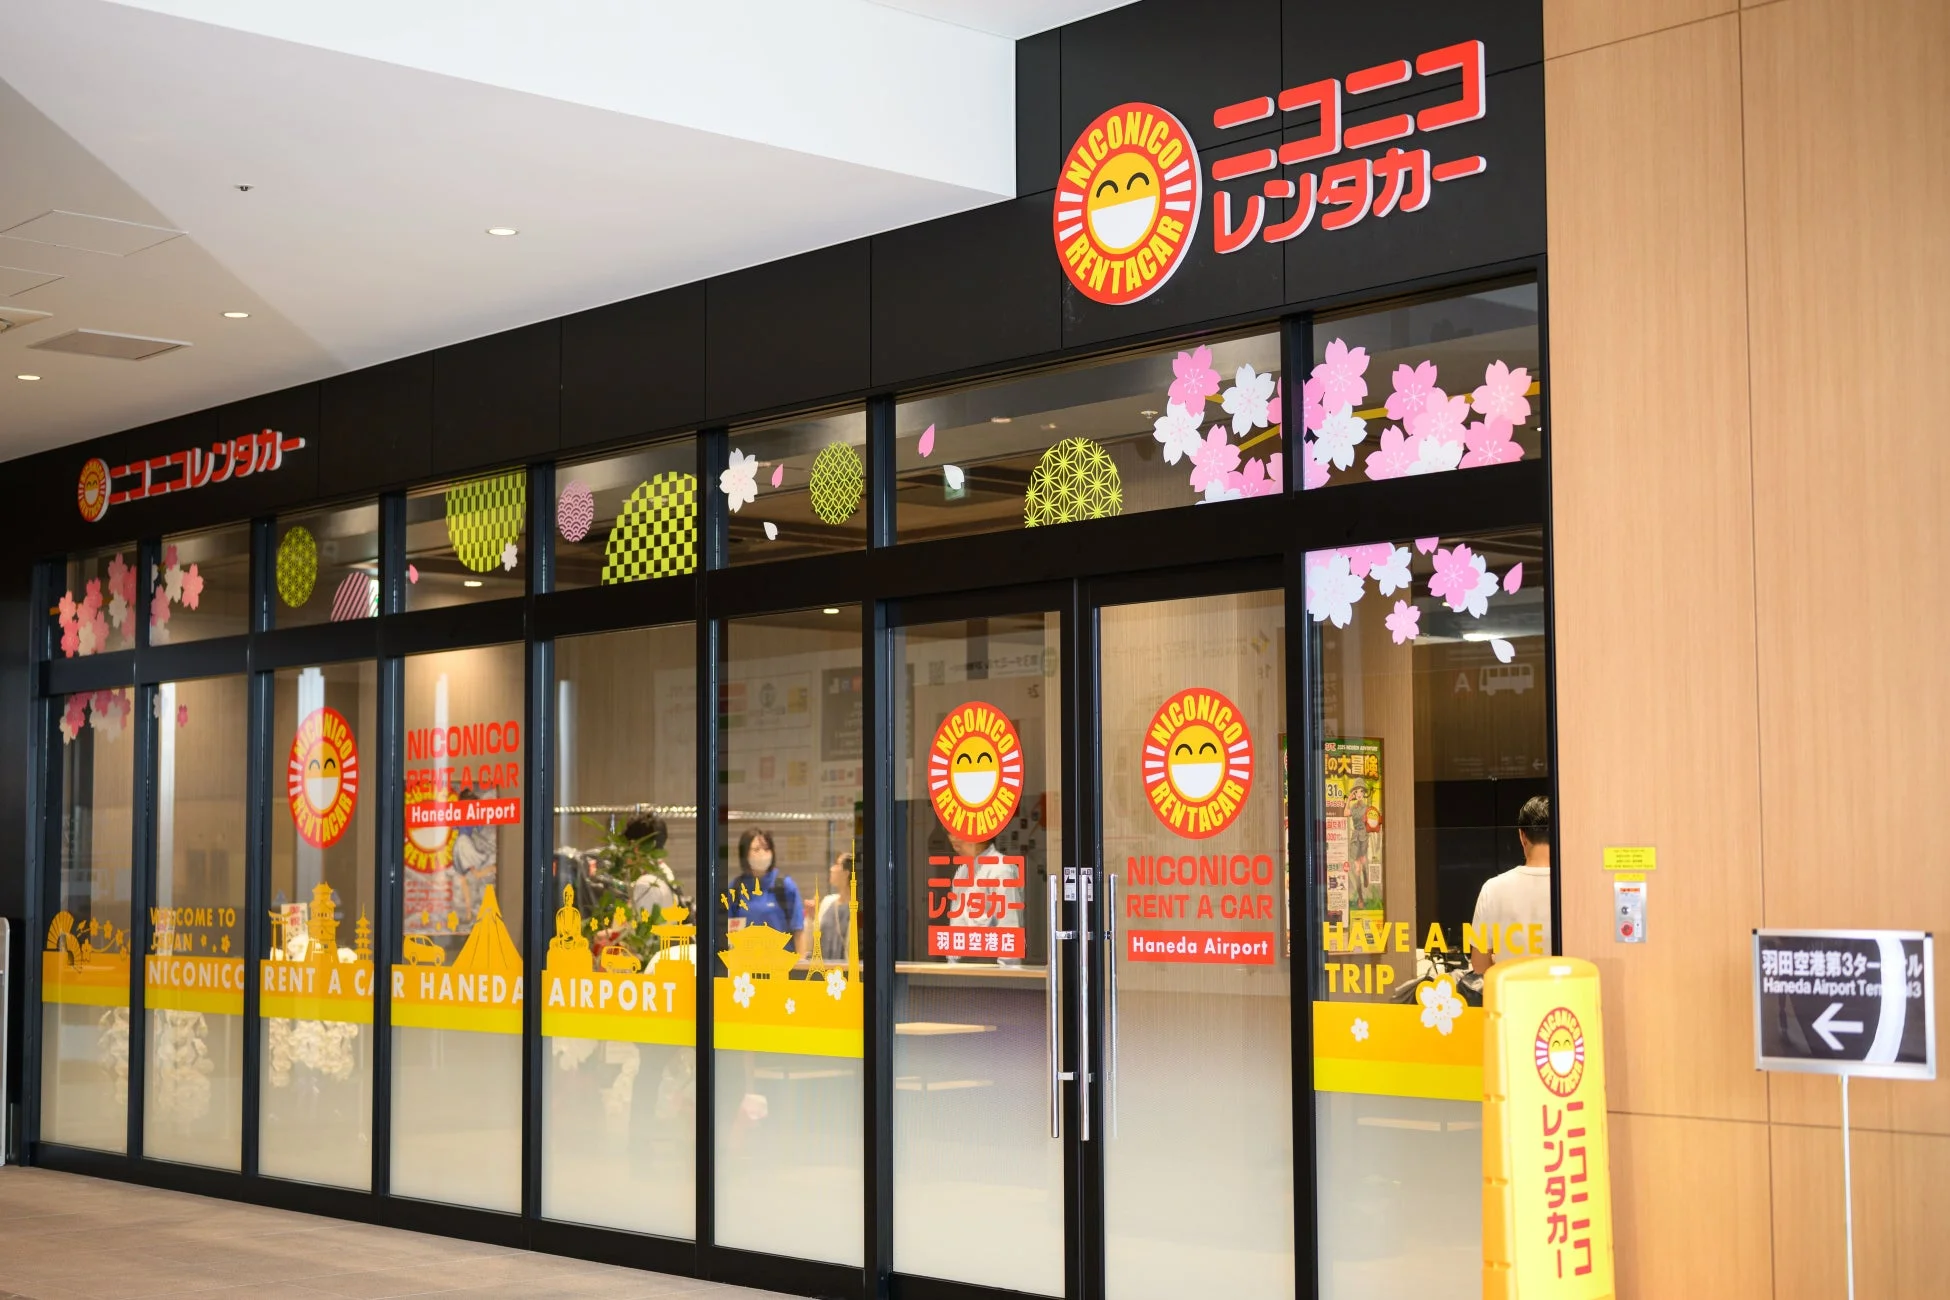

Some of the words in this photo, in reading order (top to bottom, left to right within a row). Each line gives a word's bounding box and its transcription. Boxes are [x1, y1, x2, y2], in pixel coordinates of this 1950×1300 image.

[1212, 40, 1486, 181] ニコニコ
[1066, 111, 1183, 187] NICONICO
[1213, 149, 1487, 254] レンタカー
[1065, 215, 1184, 293] RENTACAR
[109, 429, 306, 504] ニコニコレンタカー
[294, 712, 352, 760] NICONICO
[407, 720, 520, 761] NICONICO
[936, 707, 1014, 756] NICONICO
[1151, 694, 1243, 747] NICONICO
[406, 767, 455, 793] RENT
[460, 766, 474, 792] A
[478, 762, 519, 790] CAR
[1325, 754, 1379, 778] の大冒険
[293, 792, 352, 842] RENTACAR
[412, 803, 461, 823] Haneda
[466, 803, 515, 824] Airport
[936, 786, 1016, 836] RENTACAR
[1151, 779, 1245, 833] RENTACAR
[928, 856, 1025, 887] ニコニコ
[1127, 854, 1274, 887] NICONICO
[218, 907, 236, 928] TO
[928, 891, 1025, 919] レンタカー
[1127, 894, 1190, 920] RENT
[1197, 894, 1214, 919] A
[1220, 894, 1273, 920] CAR
[936, 931, 1016, 952] 羽田空港店
[1132, 936, 1197, 955] Haneda
[1204, 938, 1268, 959] Airport
[1323, 921, 1410, 953] HAVE
[1424, 922, 1448, 953] A
[1462, 922, 1544, 955] NICE
[1324, 963, 1395, 995] TRIP
[1762, 950, 1923, 977] 羽田空港第3タール
[264, 965, 316, 993] RENT
[328, 968, 342, 994] A
[420, 971, 524, 1004] HANEDA
[548, 977, 676, 1013] AIRPORT
[1763, 977, 1811, 994] Haneda
[1813, 978, 1856, 997] Airport
[1542, 1104, 1568, 1279] レンタカー
[1566, 1101, 1592, 1276] ニコニコ
